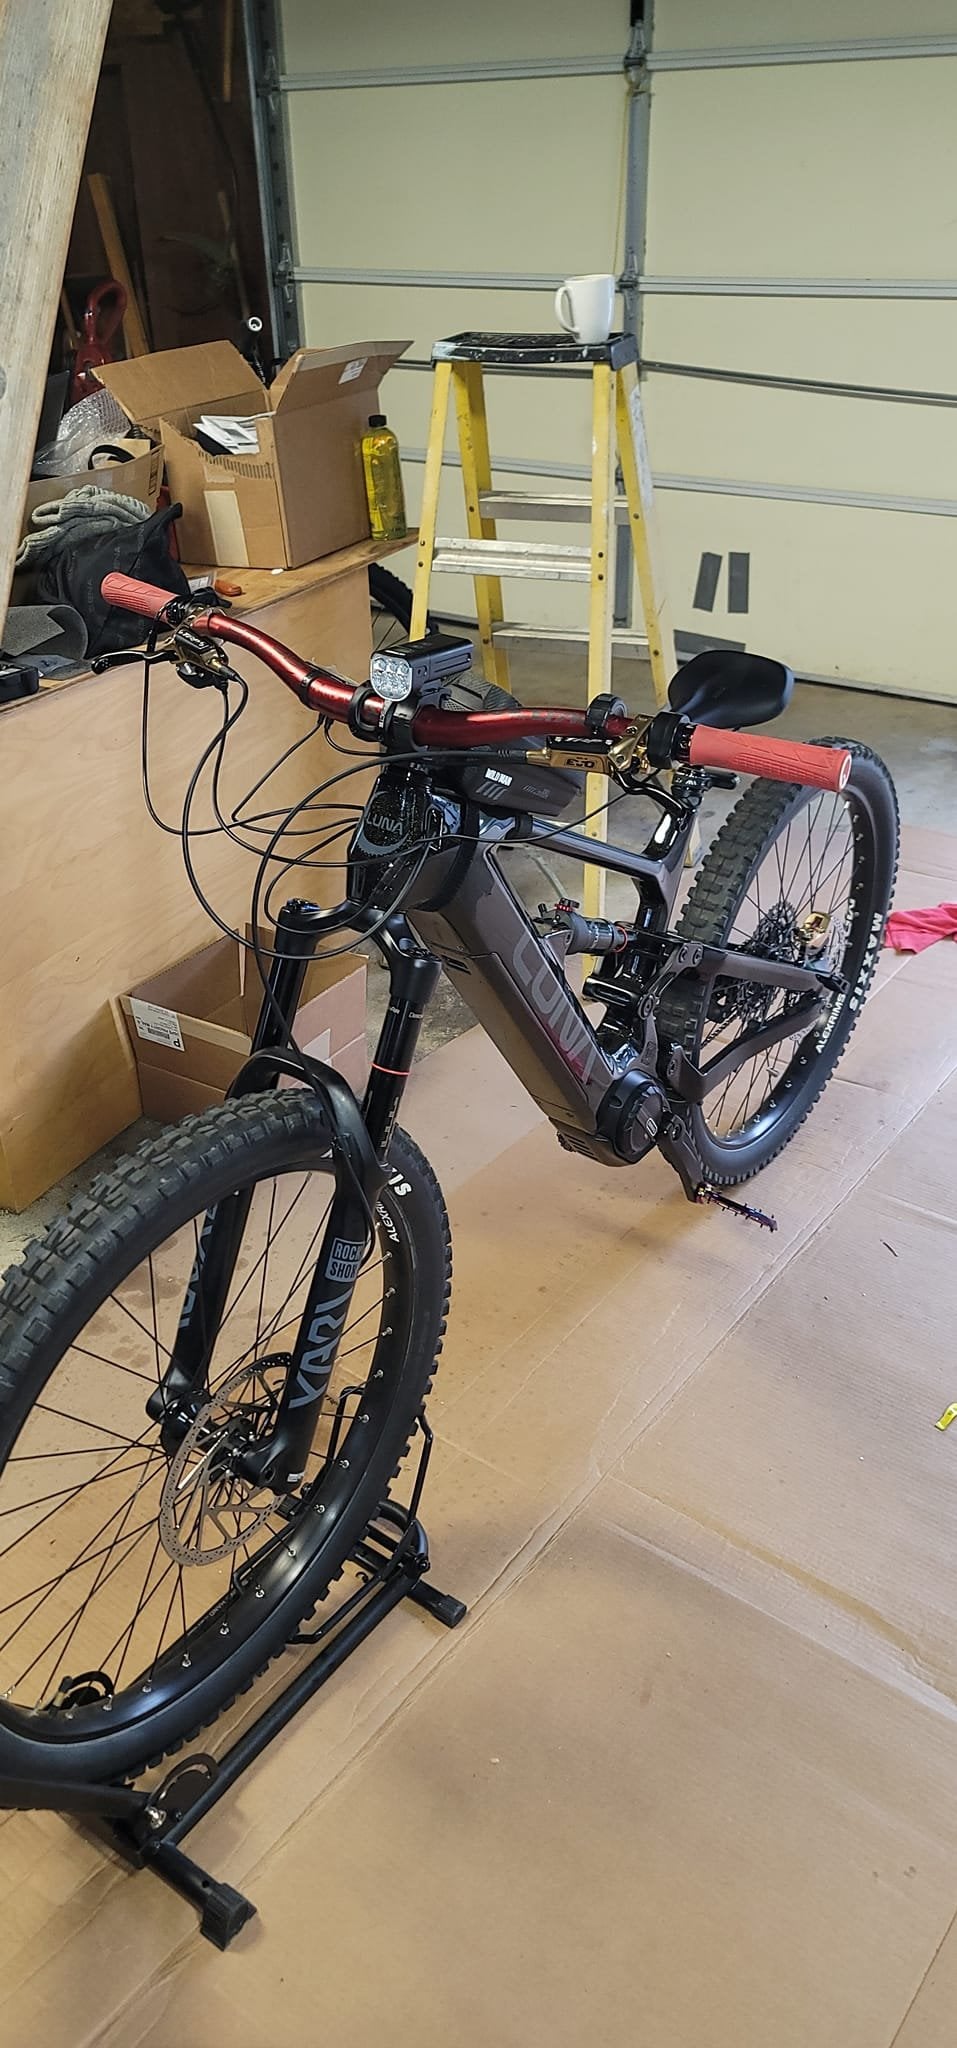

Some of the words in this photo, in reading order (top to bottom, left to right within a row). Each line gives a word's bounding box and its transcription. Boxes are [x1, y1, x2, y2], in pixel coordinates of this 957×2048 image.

[366, 812, 403, 835] LUNA
[850, 912, 883, 1012] MAXXIS
[815, 993, 847, 1053] ALEXRIMS
[288, 1286, 353, 1409] YARI
